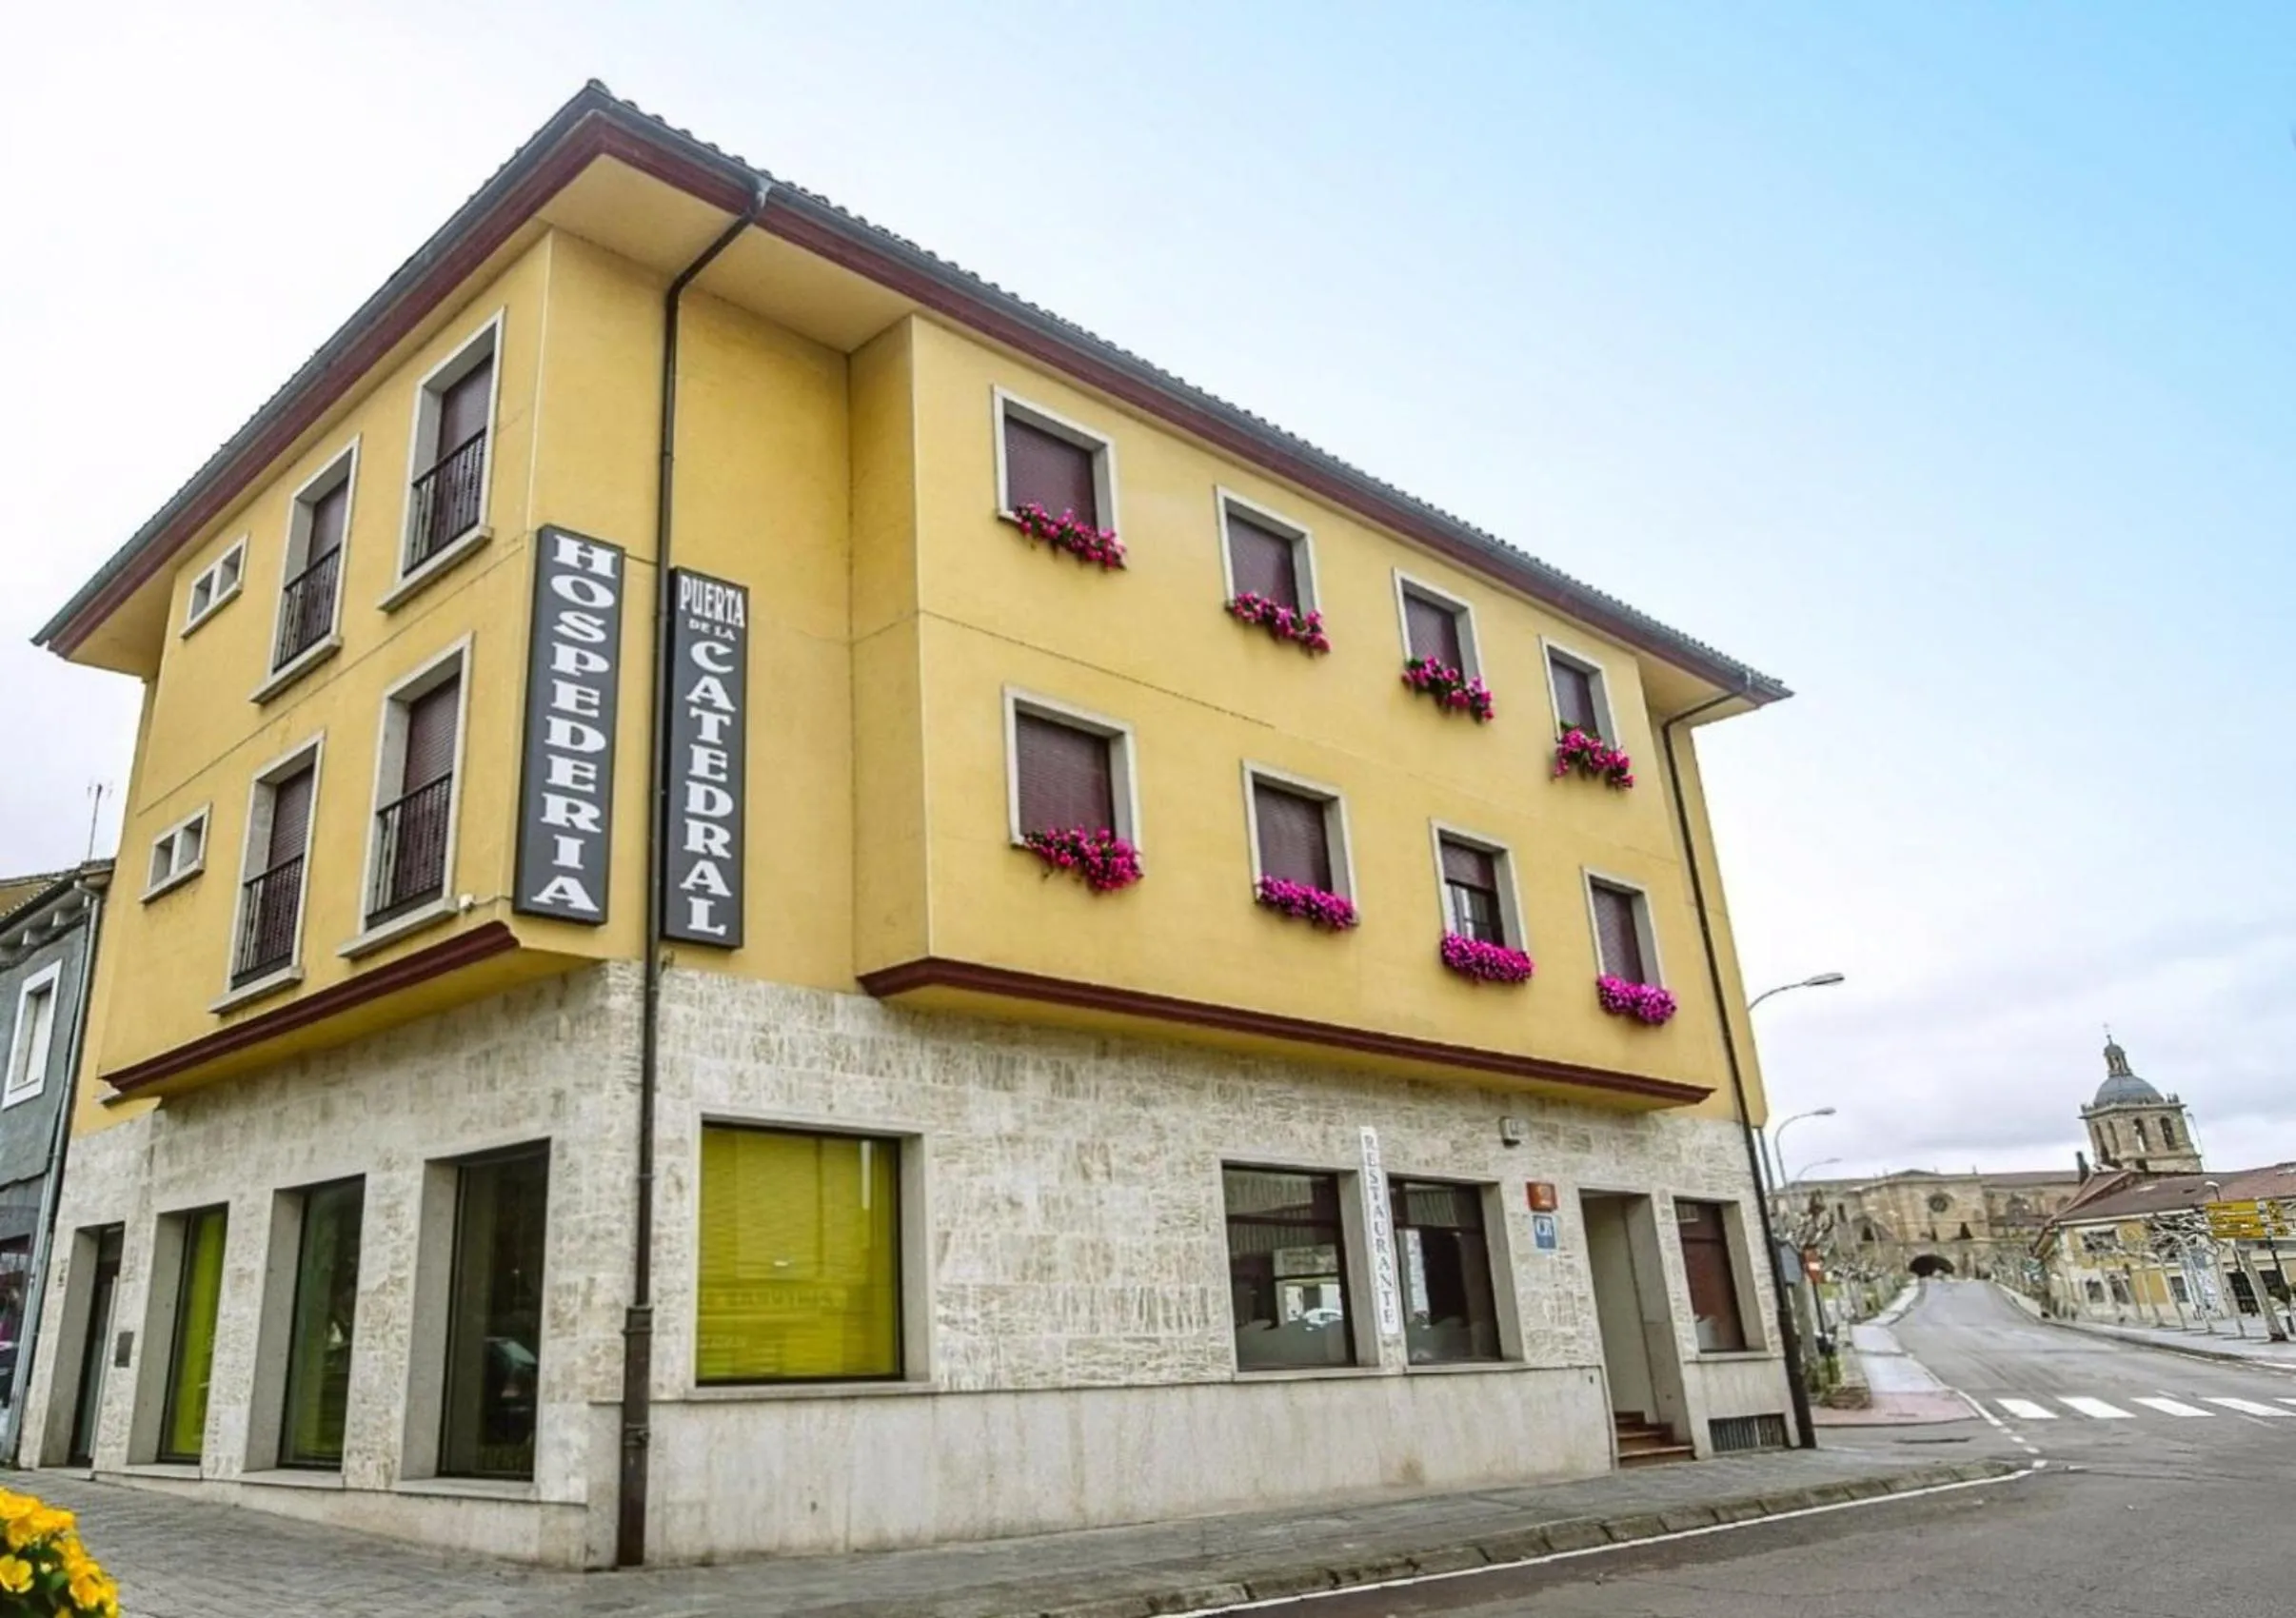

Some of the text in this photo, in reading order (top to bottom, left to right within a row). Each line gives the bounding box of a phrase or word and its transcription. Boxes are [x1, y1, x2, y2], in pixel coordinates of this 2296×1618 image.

[679, 574, 745, 629] PUERTA
[688, 617, 737, 642] DE LA
[531, 534, 617, 912] HOSPEDERIA
[679, 640, 737, 937] CATEDRAL
[1363, 1134, 1395, 1325] RESTAURANTE
